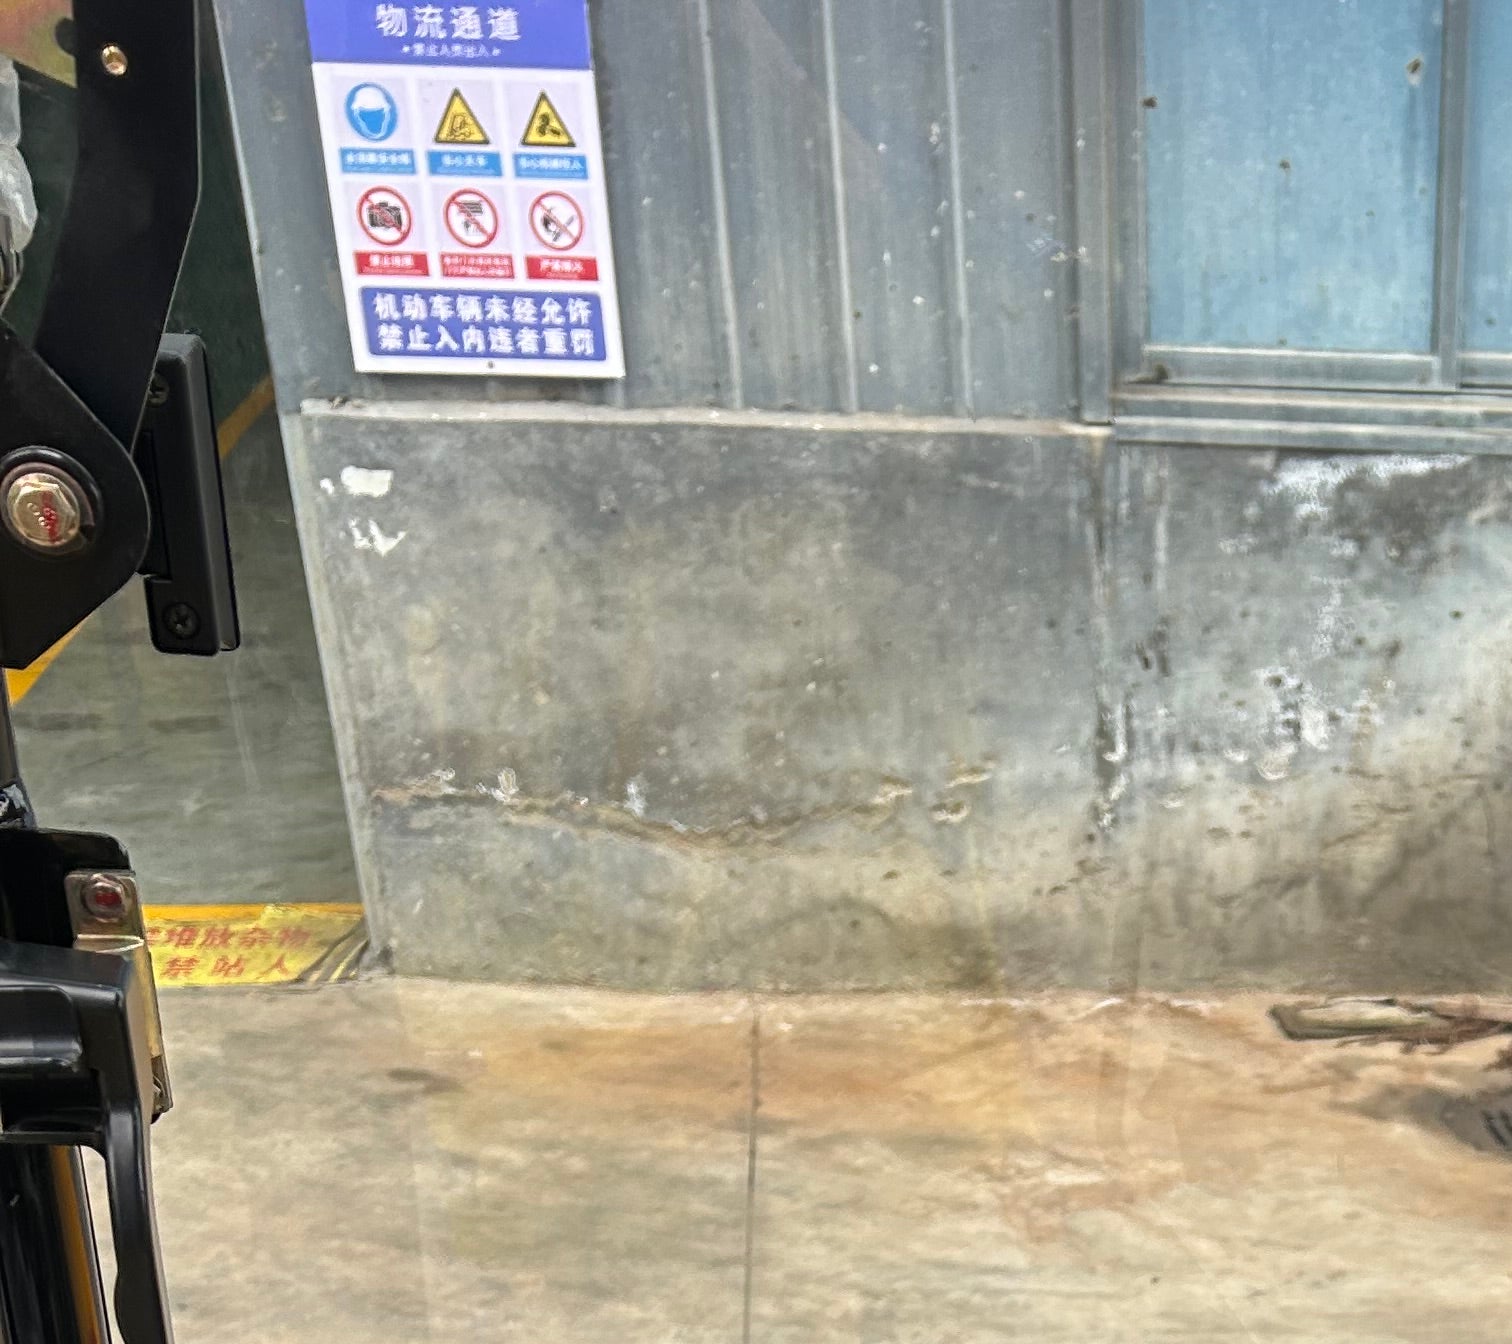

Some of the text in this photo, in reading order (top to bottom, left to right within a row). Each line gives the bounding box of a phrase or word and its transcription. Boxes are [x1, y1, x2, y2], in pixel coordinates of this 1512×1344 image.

[376, 3, 521, 40] 物流通道
[374, 292, 593, 325] 机动车辆未经允许
